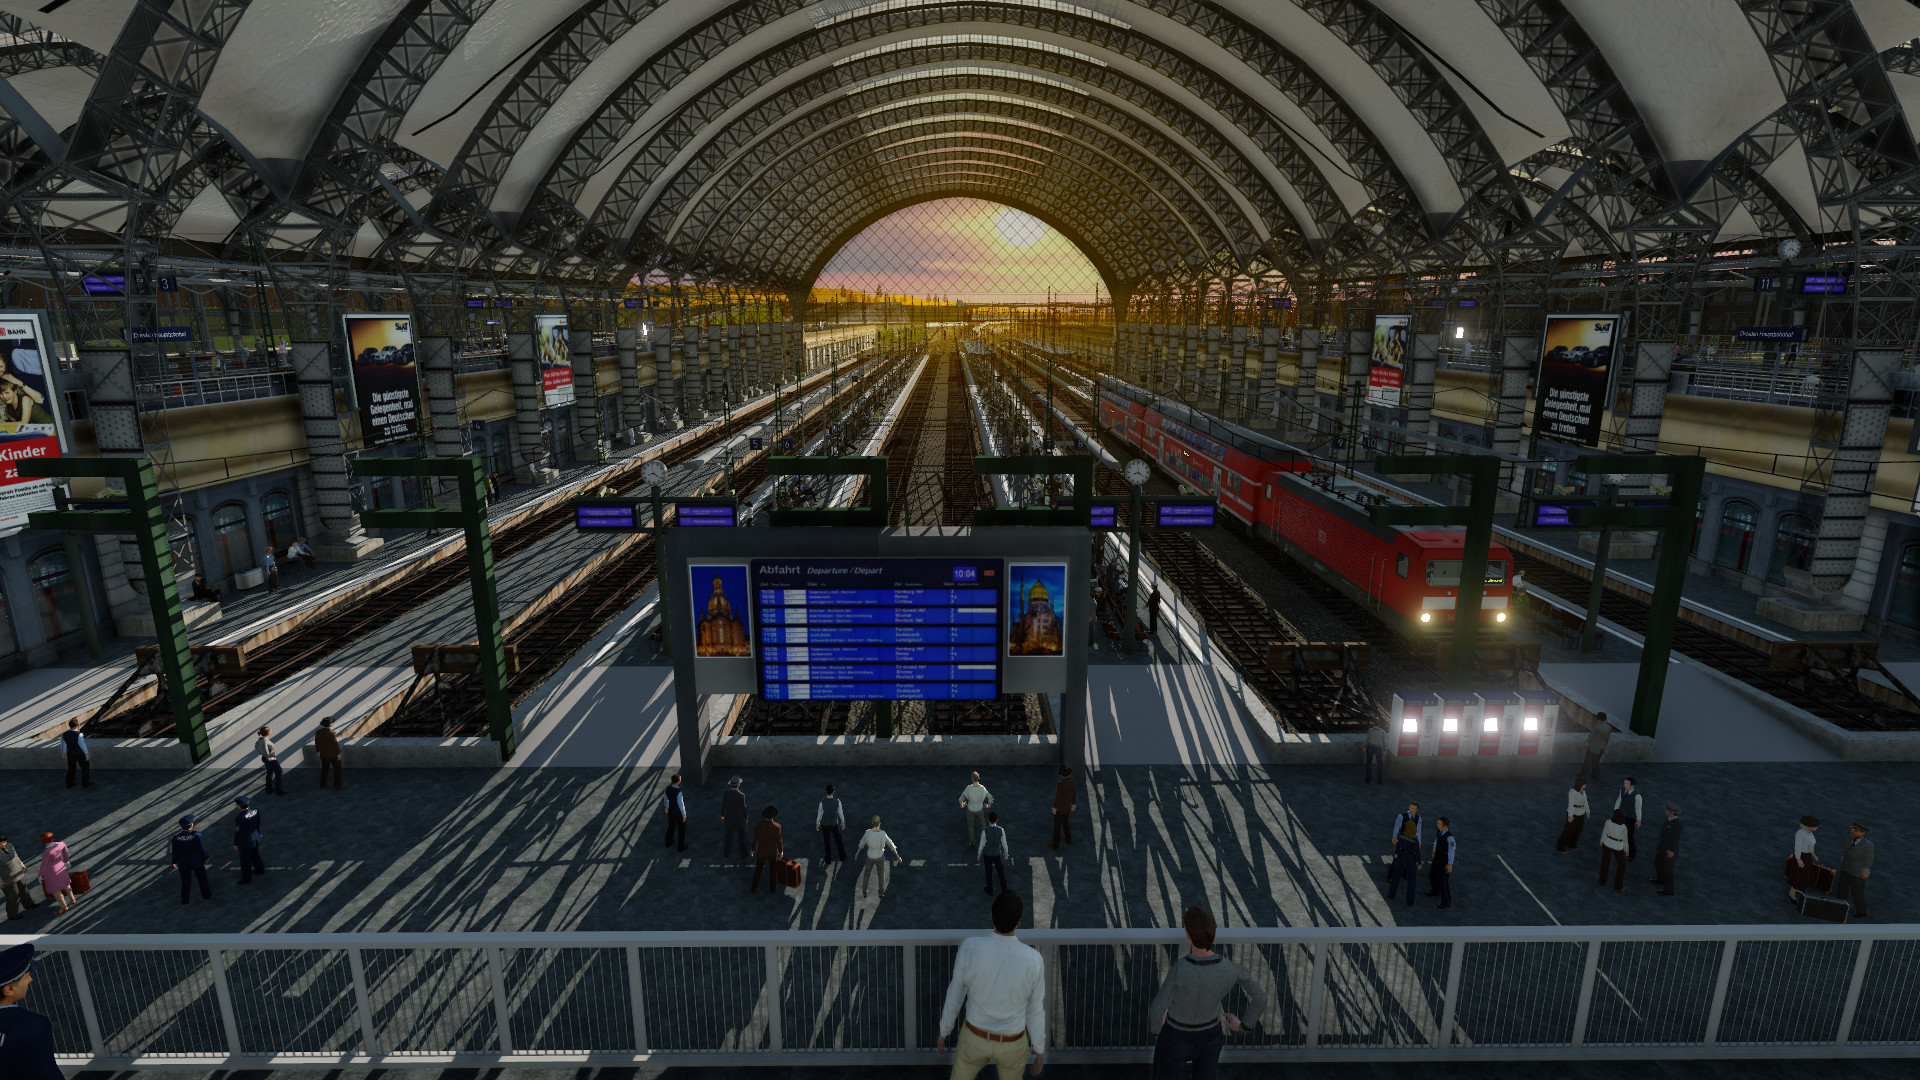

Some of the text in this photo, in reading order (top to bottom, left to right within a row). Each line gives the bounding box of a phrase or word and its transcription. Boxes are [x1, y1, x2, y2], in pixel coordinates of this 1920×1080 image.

[162, 278, 169, 290] 3
[1761, 278, 1770, 290] 11
[372, 392, 382, 402] Die
[1549, 387, 1590, 402] Die günstigste
[372, 415, 388, 426] einen
[1559, 411, 1590, 425] Deutschen
[752, 439, 758, 448] 5
[784, 439, 790, 448] 6
[0, 446, 46, 462] Kinder
[759, 566, 800, 574] Abfahrt
[807, 566, 848, 575] Departure
[954, 570, 975, 578] 10:04
